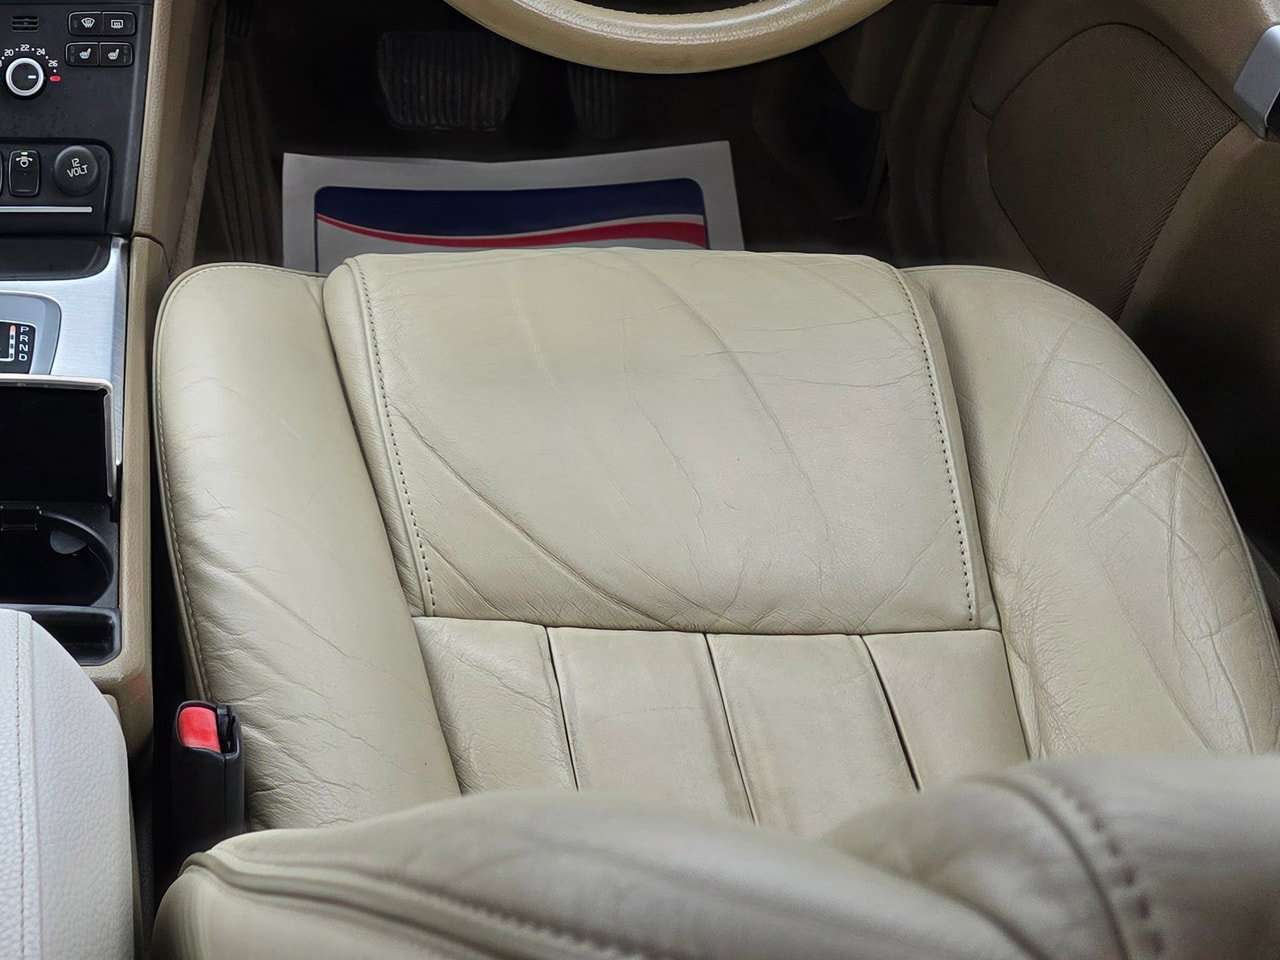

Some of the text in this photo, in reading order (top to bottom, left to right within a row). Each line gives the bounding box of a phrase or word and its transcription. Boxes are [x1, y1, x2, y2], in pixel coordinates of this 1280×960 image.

[4, 48, 15, 57] 20
[20, 44, 30, 52] 22
[36, 48, 46, 56] 24
[48, 59, 58, 67] 26
[71, 158, 81, 167] 12
[66, 164, 89, 178] VOLT
[19, 344, 29, 352] N
[18, 353, 28, 361] D
